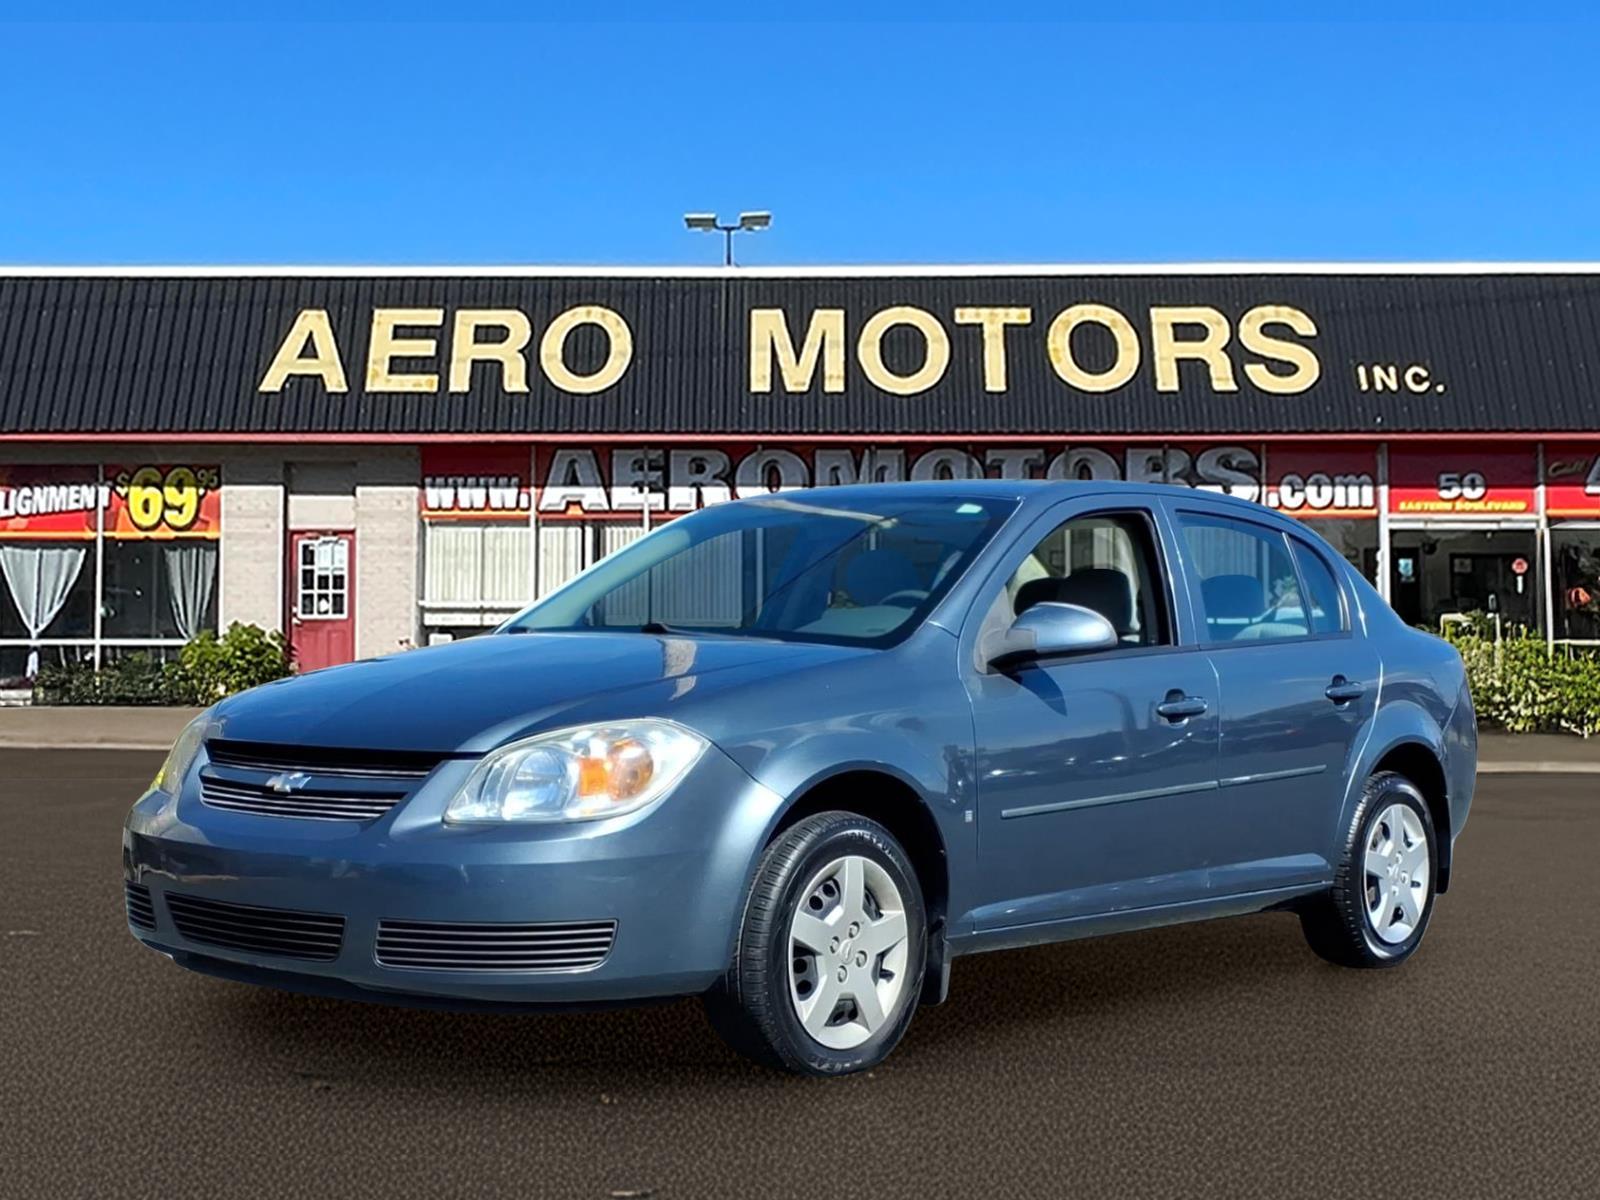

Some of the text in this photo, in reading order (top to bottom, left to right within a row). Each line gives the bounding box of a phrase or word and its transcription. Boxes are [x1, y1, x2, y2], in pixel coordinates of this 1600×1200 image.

[258, 304, 1446, 395] AERO MOTORS INC.
[1437, 473, 1486, 500] 50
